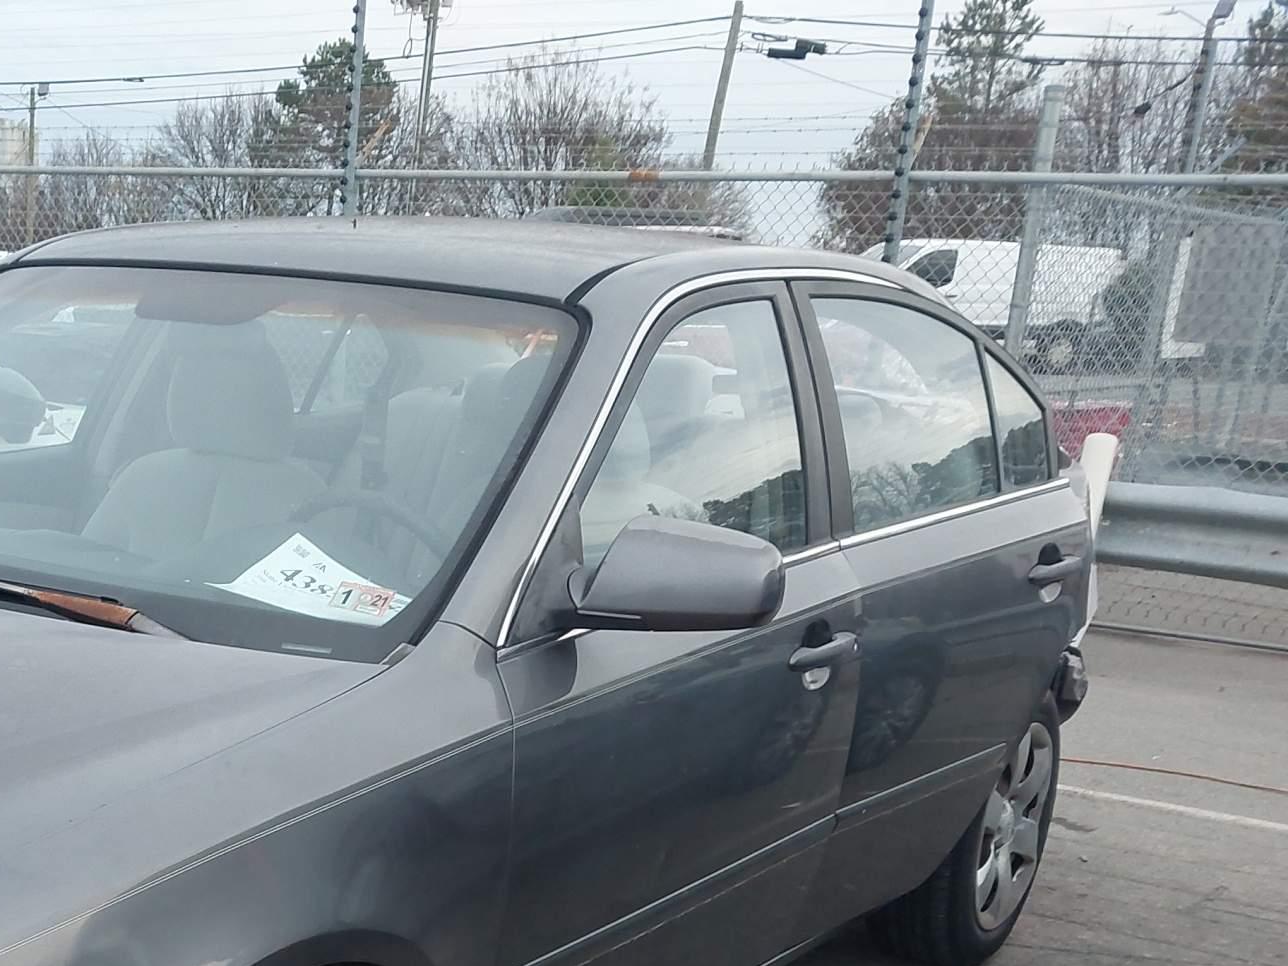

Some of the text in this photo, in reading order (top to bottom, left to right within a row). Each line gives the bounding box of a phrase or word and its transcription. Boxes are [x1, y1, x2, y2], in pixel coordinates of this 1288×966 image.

[279, 568, 336, 597] 438
[341, 588, 354, 605] 1
[369, 593, 390, 608] 21
